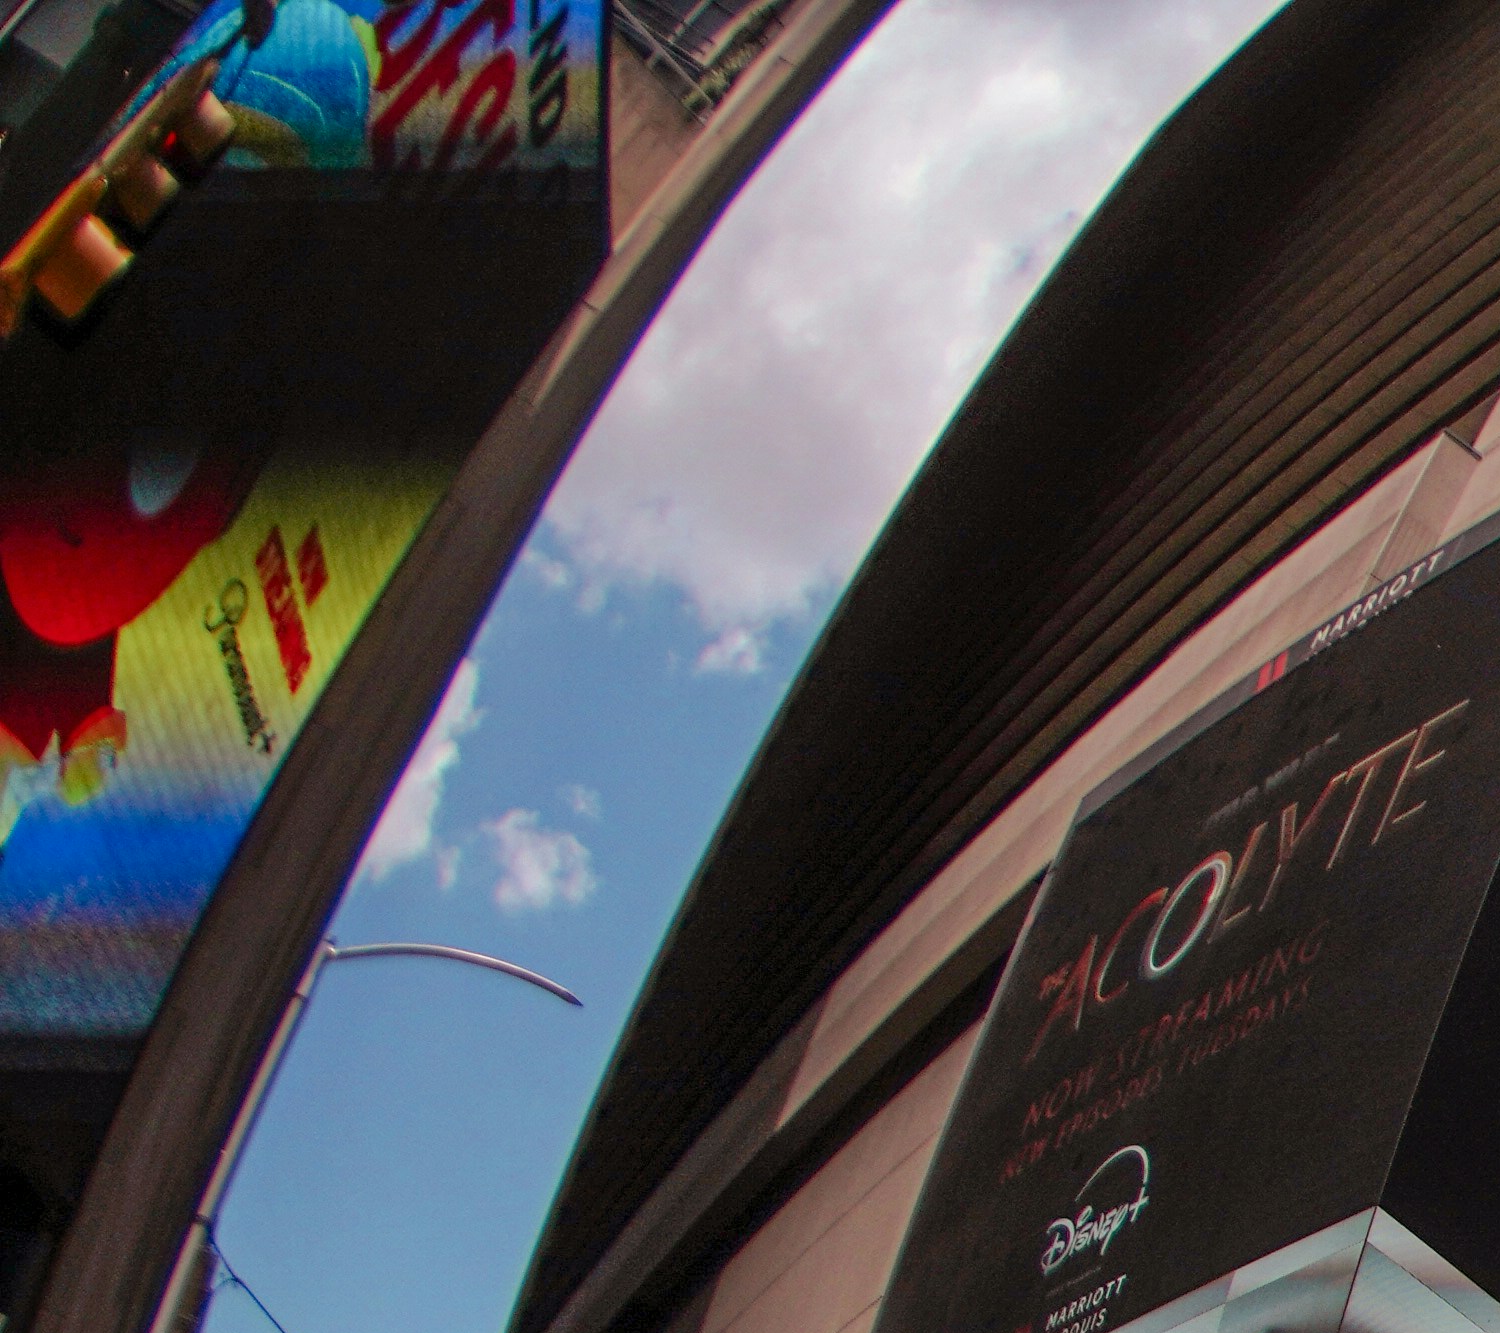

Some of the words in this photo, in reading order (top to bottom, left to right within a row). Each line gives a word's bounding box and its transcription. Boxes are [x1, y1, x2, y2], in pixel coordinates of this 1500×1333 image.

[1311, 549, 1444, 650] MARRIOTT
[1023, 699, 1470, 1066] ACOLYTE
[1022, 1065, 1097, 1135] NOW
[1110, 919, 1330, 1082] STREAMING
[1042, 1145, 1150, 1274] Disney+
[1045, 1273, 1129, 1331] MARRIOTT
